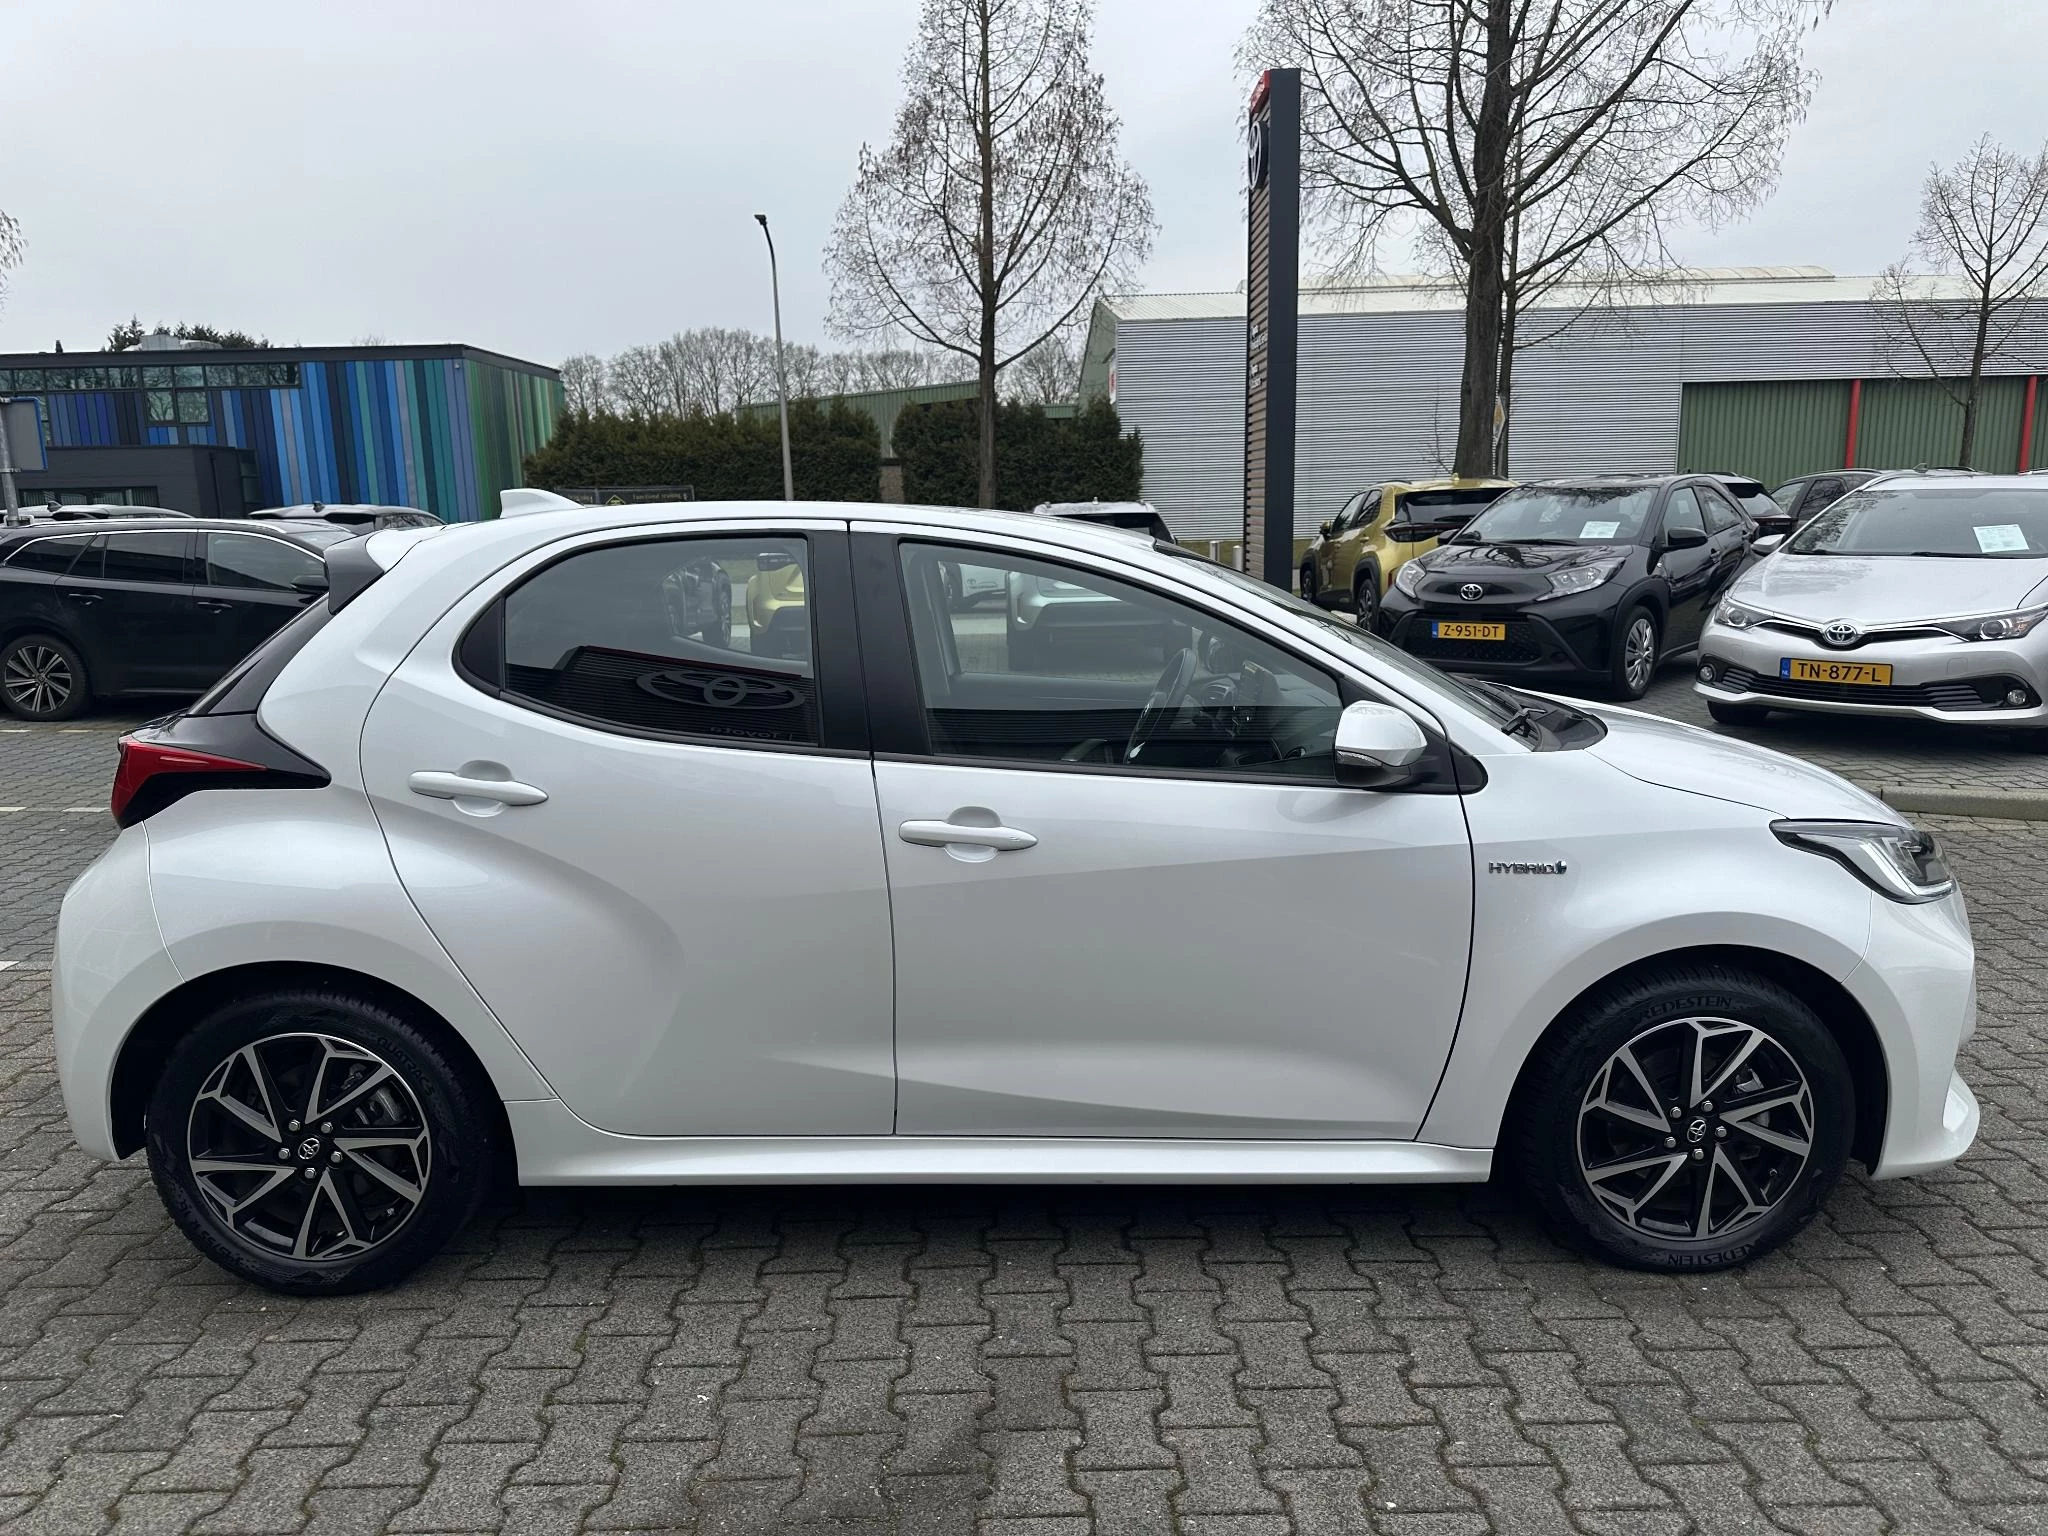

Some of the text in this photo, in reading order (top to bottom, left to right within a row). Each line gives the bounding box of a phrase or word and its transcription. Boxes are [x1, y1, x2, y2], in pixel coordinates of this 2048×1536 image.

[1443, 624, 1500, 638] Z-951-DT
[1797, 662, 1882, 683] TN-877-L
[1488, 861, 1555, 875] HYBRID
